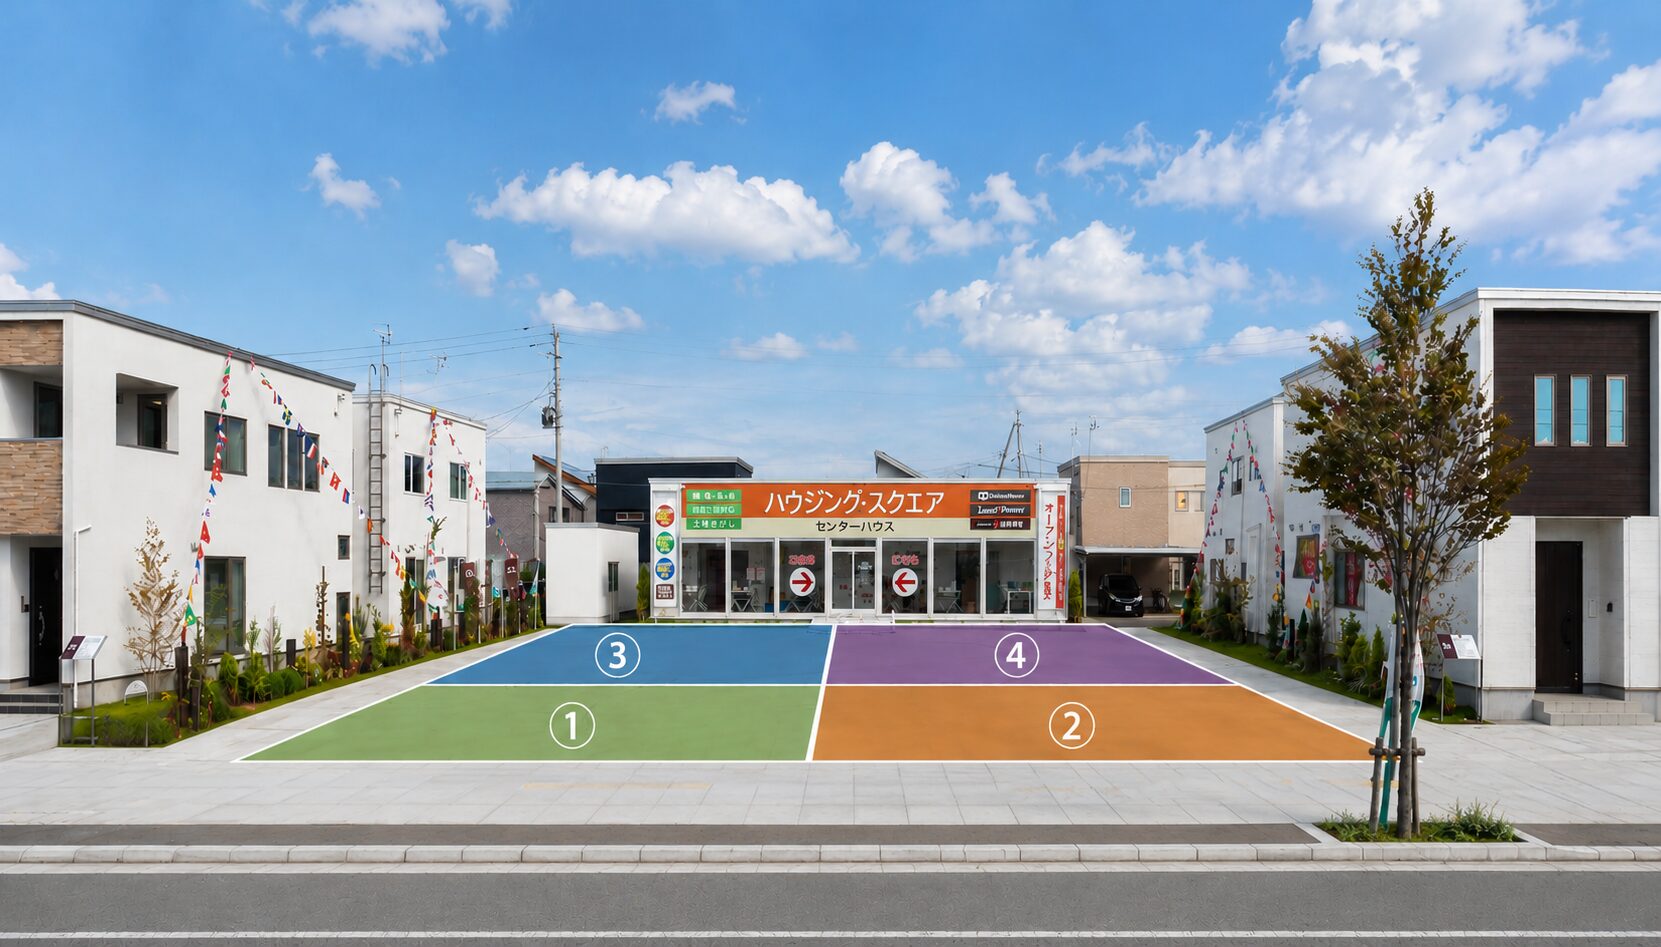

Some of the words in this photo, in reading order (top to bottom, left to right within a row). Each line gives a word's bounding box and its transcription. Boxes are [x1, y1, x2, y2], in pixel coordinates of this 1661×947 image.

[764, 489, 945, 515] ハウジング・スクエア
[815, 520, 895, 533] センターハウス
